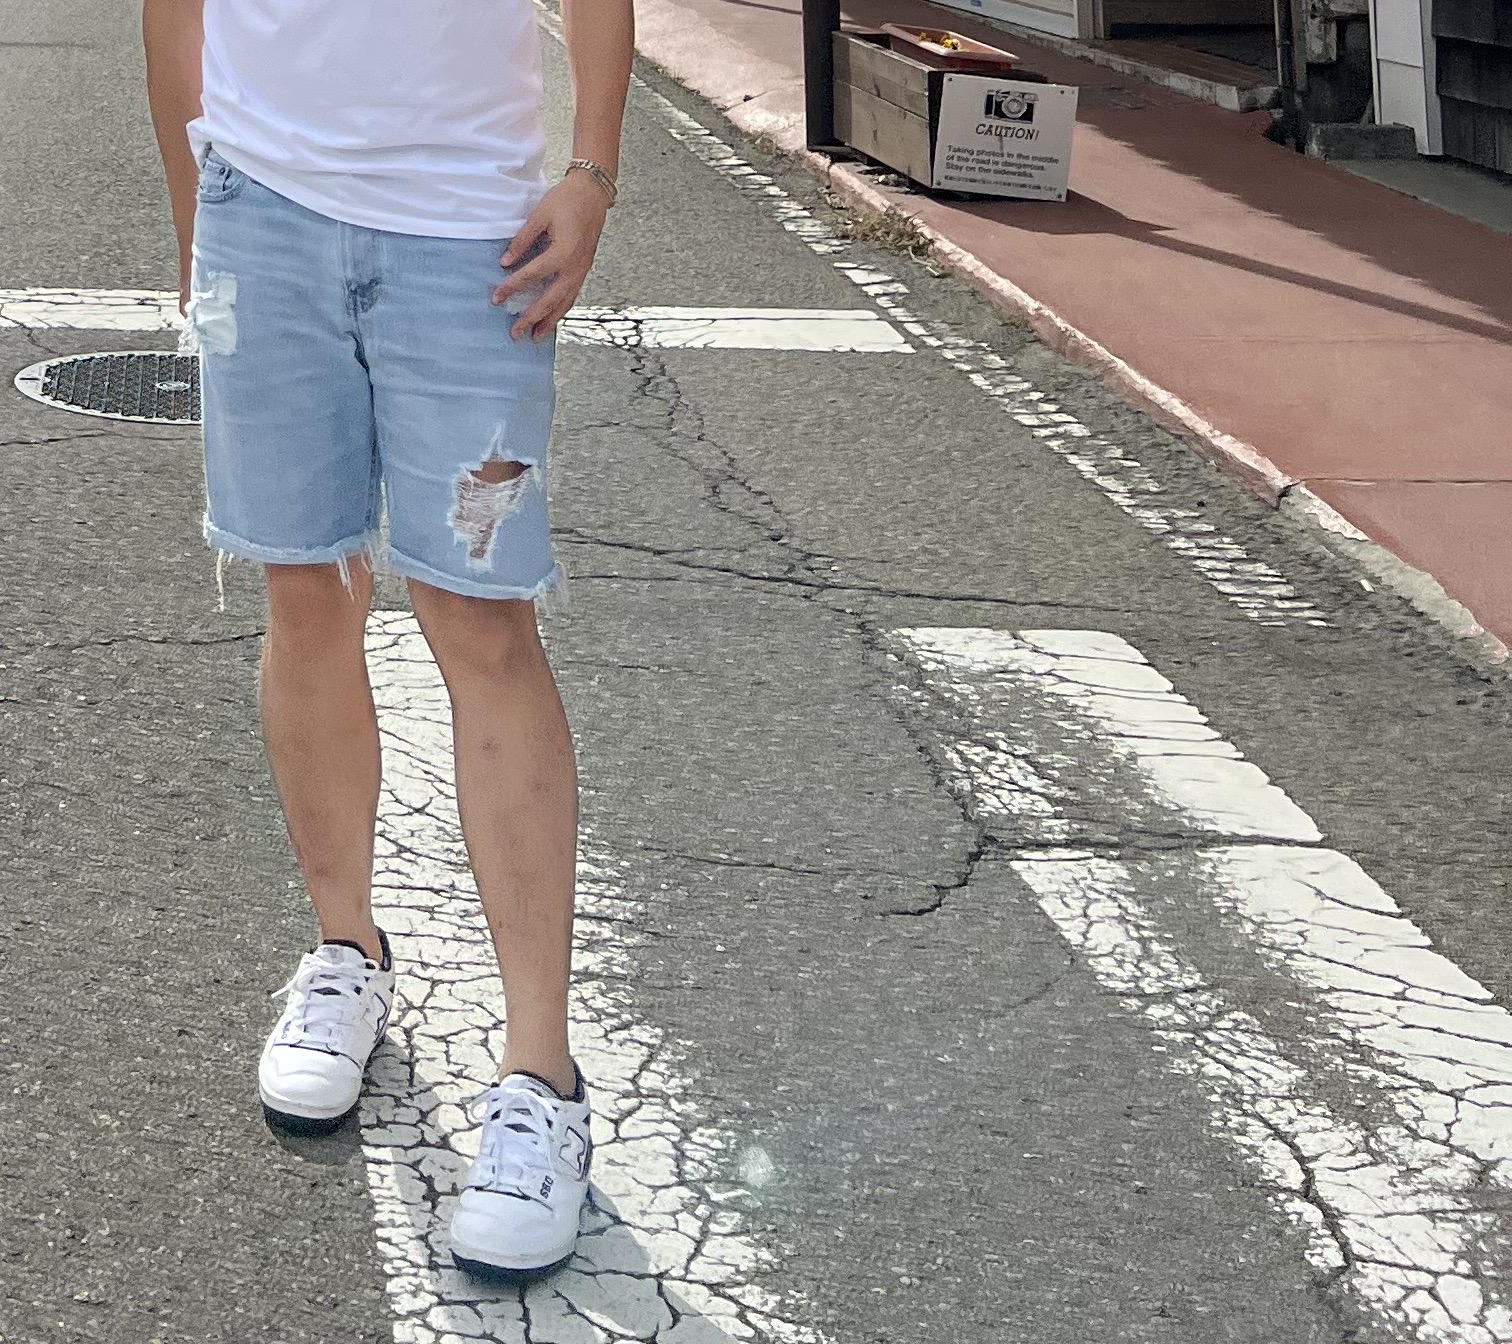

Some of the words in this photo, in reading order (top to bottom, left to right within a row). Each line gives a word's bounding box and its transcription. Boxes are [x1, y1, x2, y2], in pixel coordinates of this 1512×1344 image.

[976, 123, 1039, 141] CAUTION!
[947, 144, 975, 156] Taking
[976, 148, 1004, 158] photos
[1016, 152, 1029, 161] the
[1031, 155, 1059, 164] middle
[945, 162, 963, 172] Stay
[971, 157, 991, 166] road
